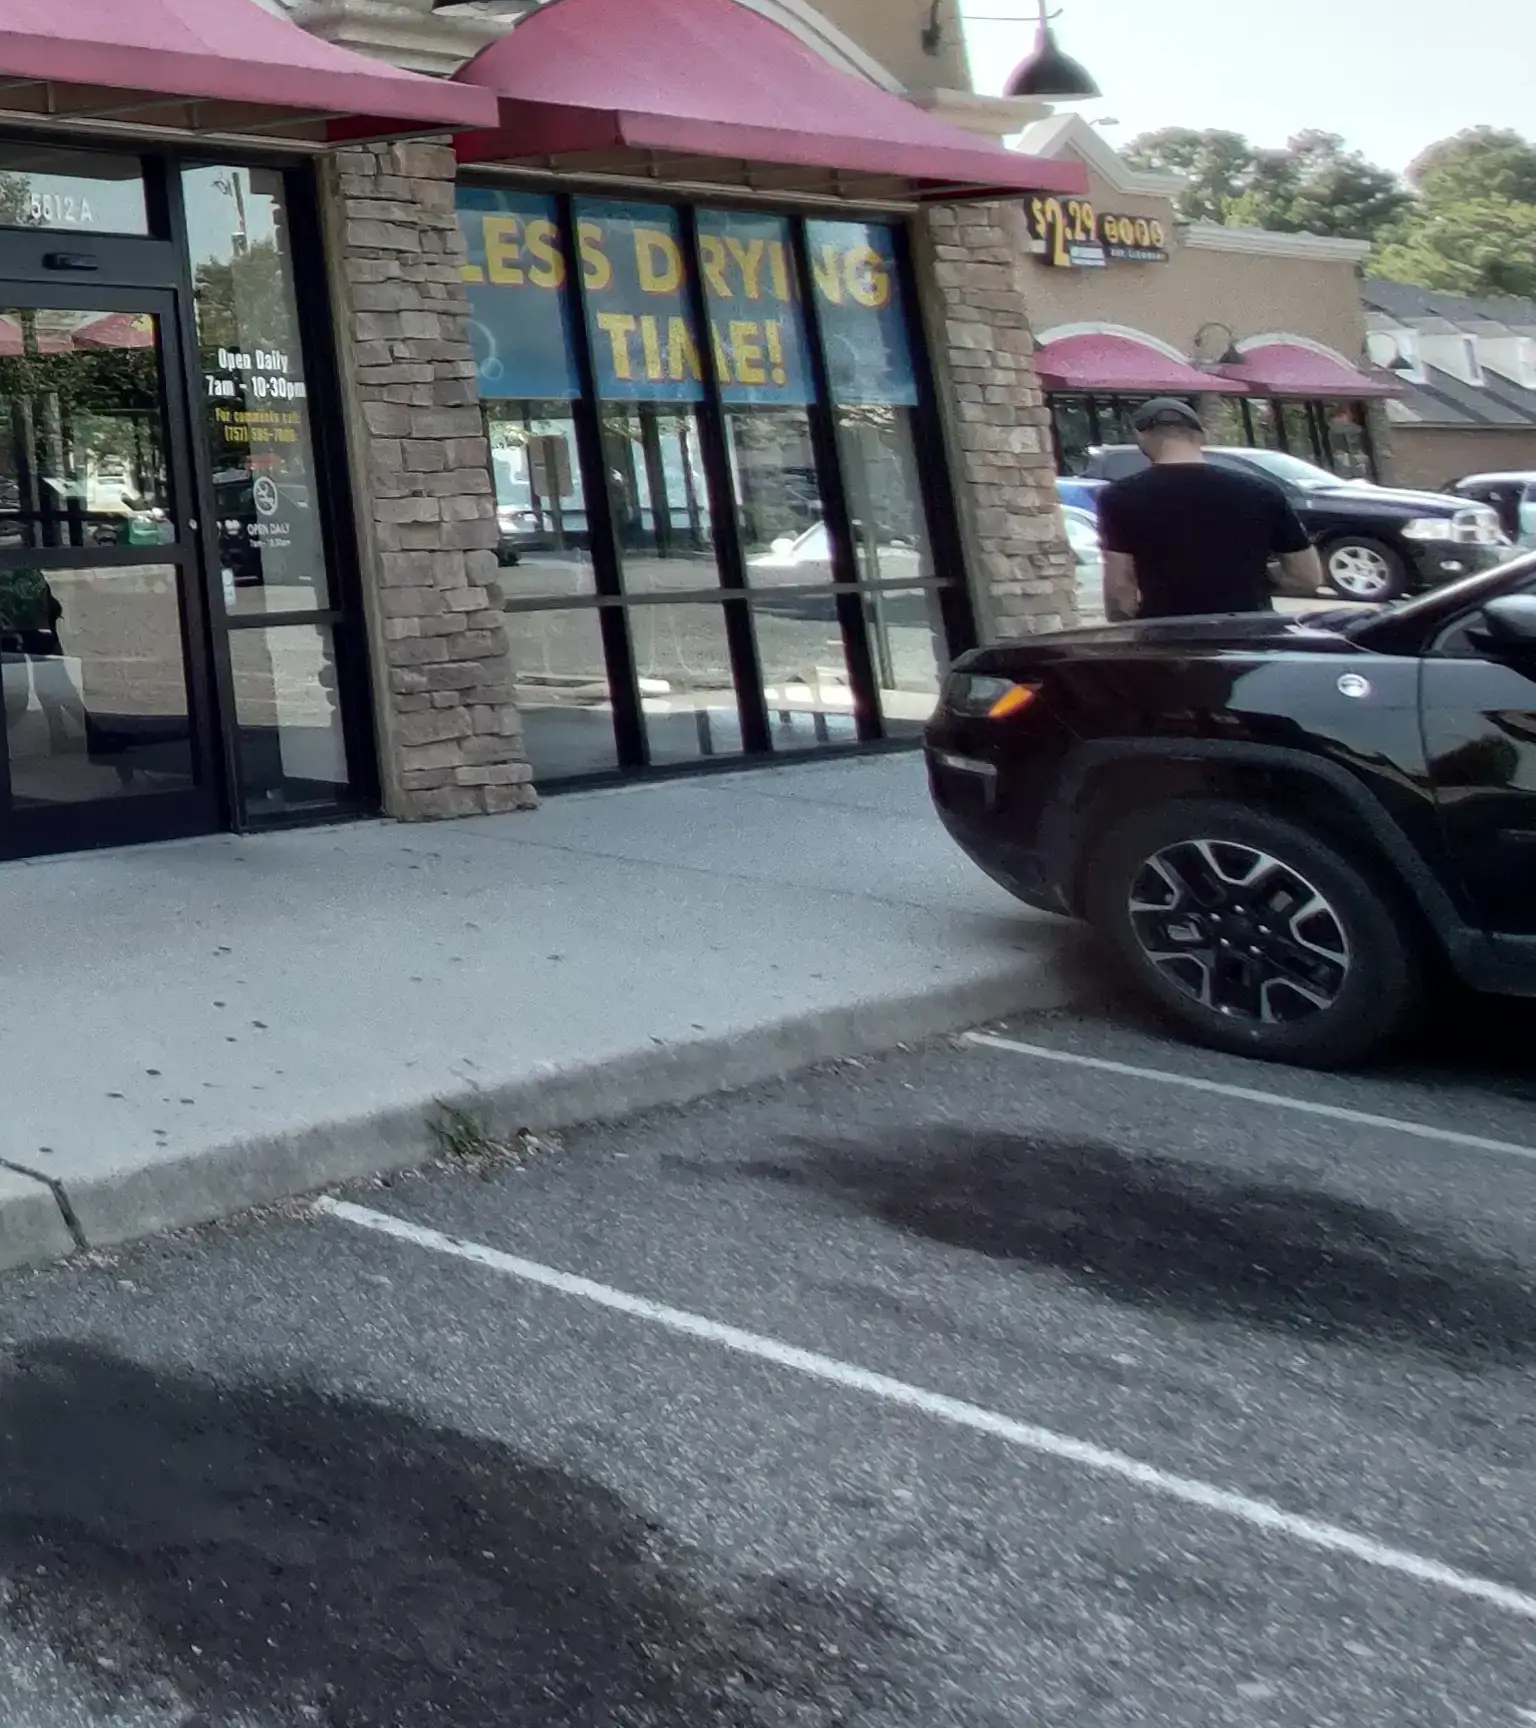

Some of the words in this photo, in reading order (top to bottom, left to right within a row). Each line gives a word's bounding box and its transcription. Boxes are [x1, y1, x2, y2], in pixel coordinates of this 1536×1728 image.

[457, 215, 612, 290] ESS
[633, 227, 891, 309] DRYING
[218, 347, 252, 372] Open
[255, 348, 288, 374] Daily
[596, 311, 787, 386] TIME!
[204, 374, 235, 397] 7am
[251, 375, 307, 401] 10:30pm
